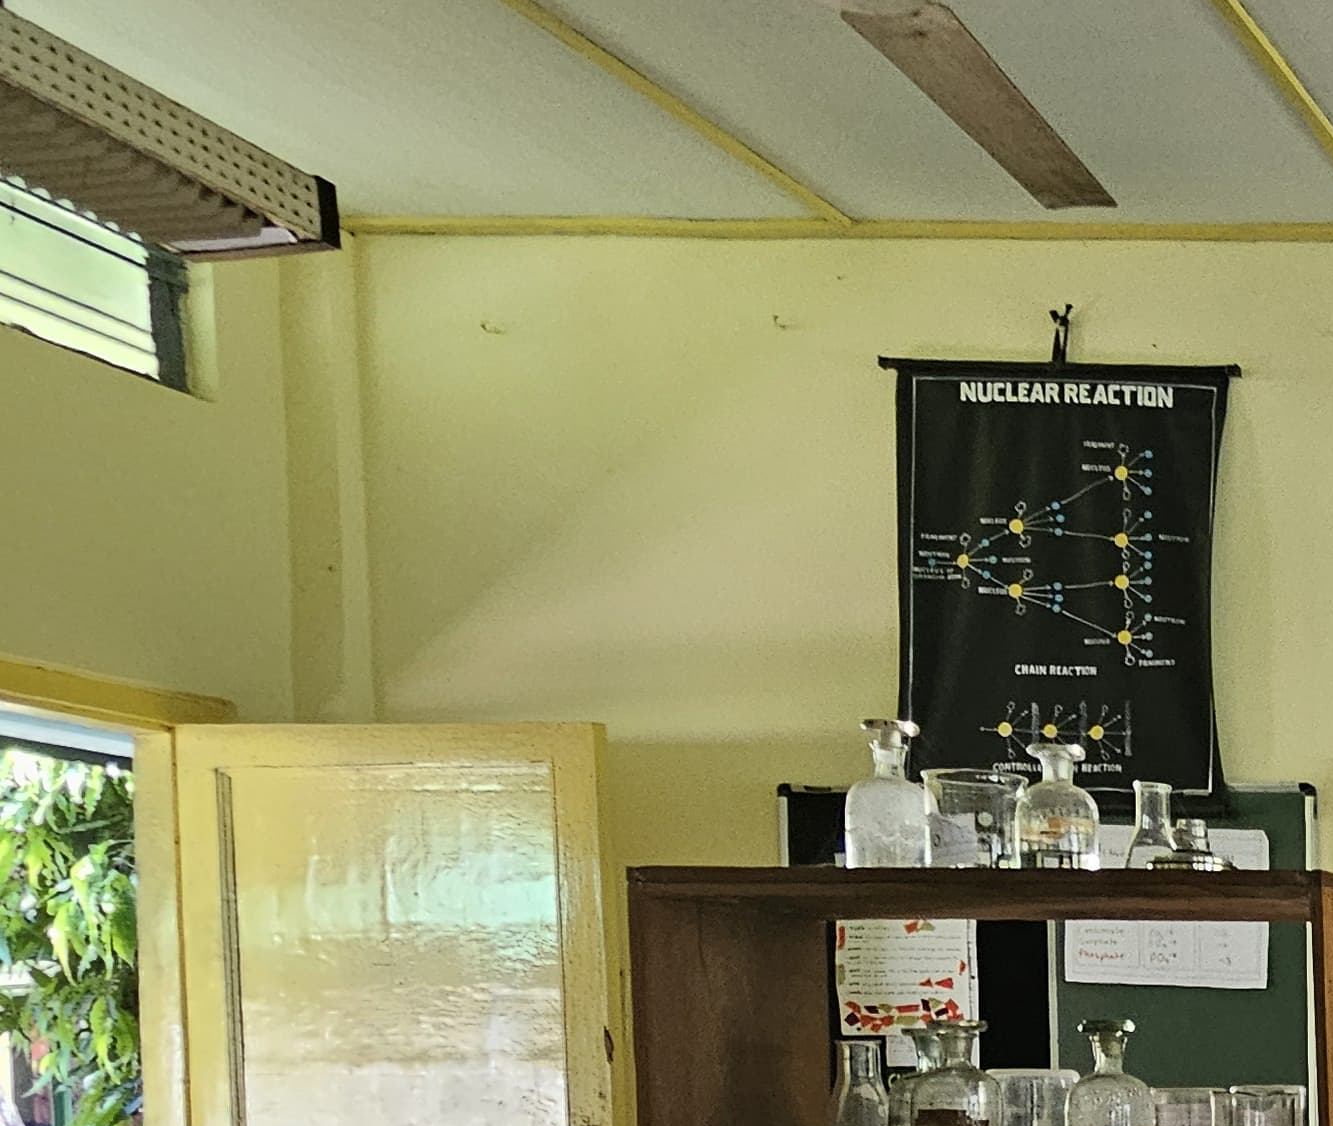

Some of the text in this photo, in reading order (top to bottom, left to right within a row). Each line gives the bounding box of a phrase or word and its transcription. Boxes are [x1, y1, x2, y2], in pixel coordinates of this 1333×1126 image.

[960, 382, 1174, 408] NUCLEAR REACTION
[1014, 664, 1097, 676] CHAIN REACTION
[992, 762, 1043, 773] CONTROLLE
[1081, 763, 1123, 774] REACTION
